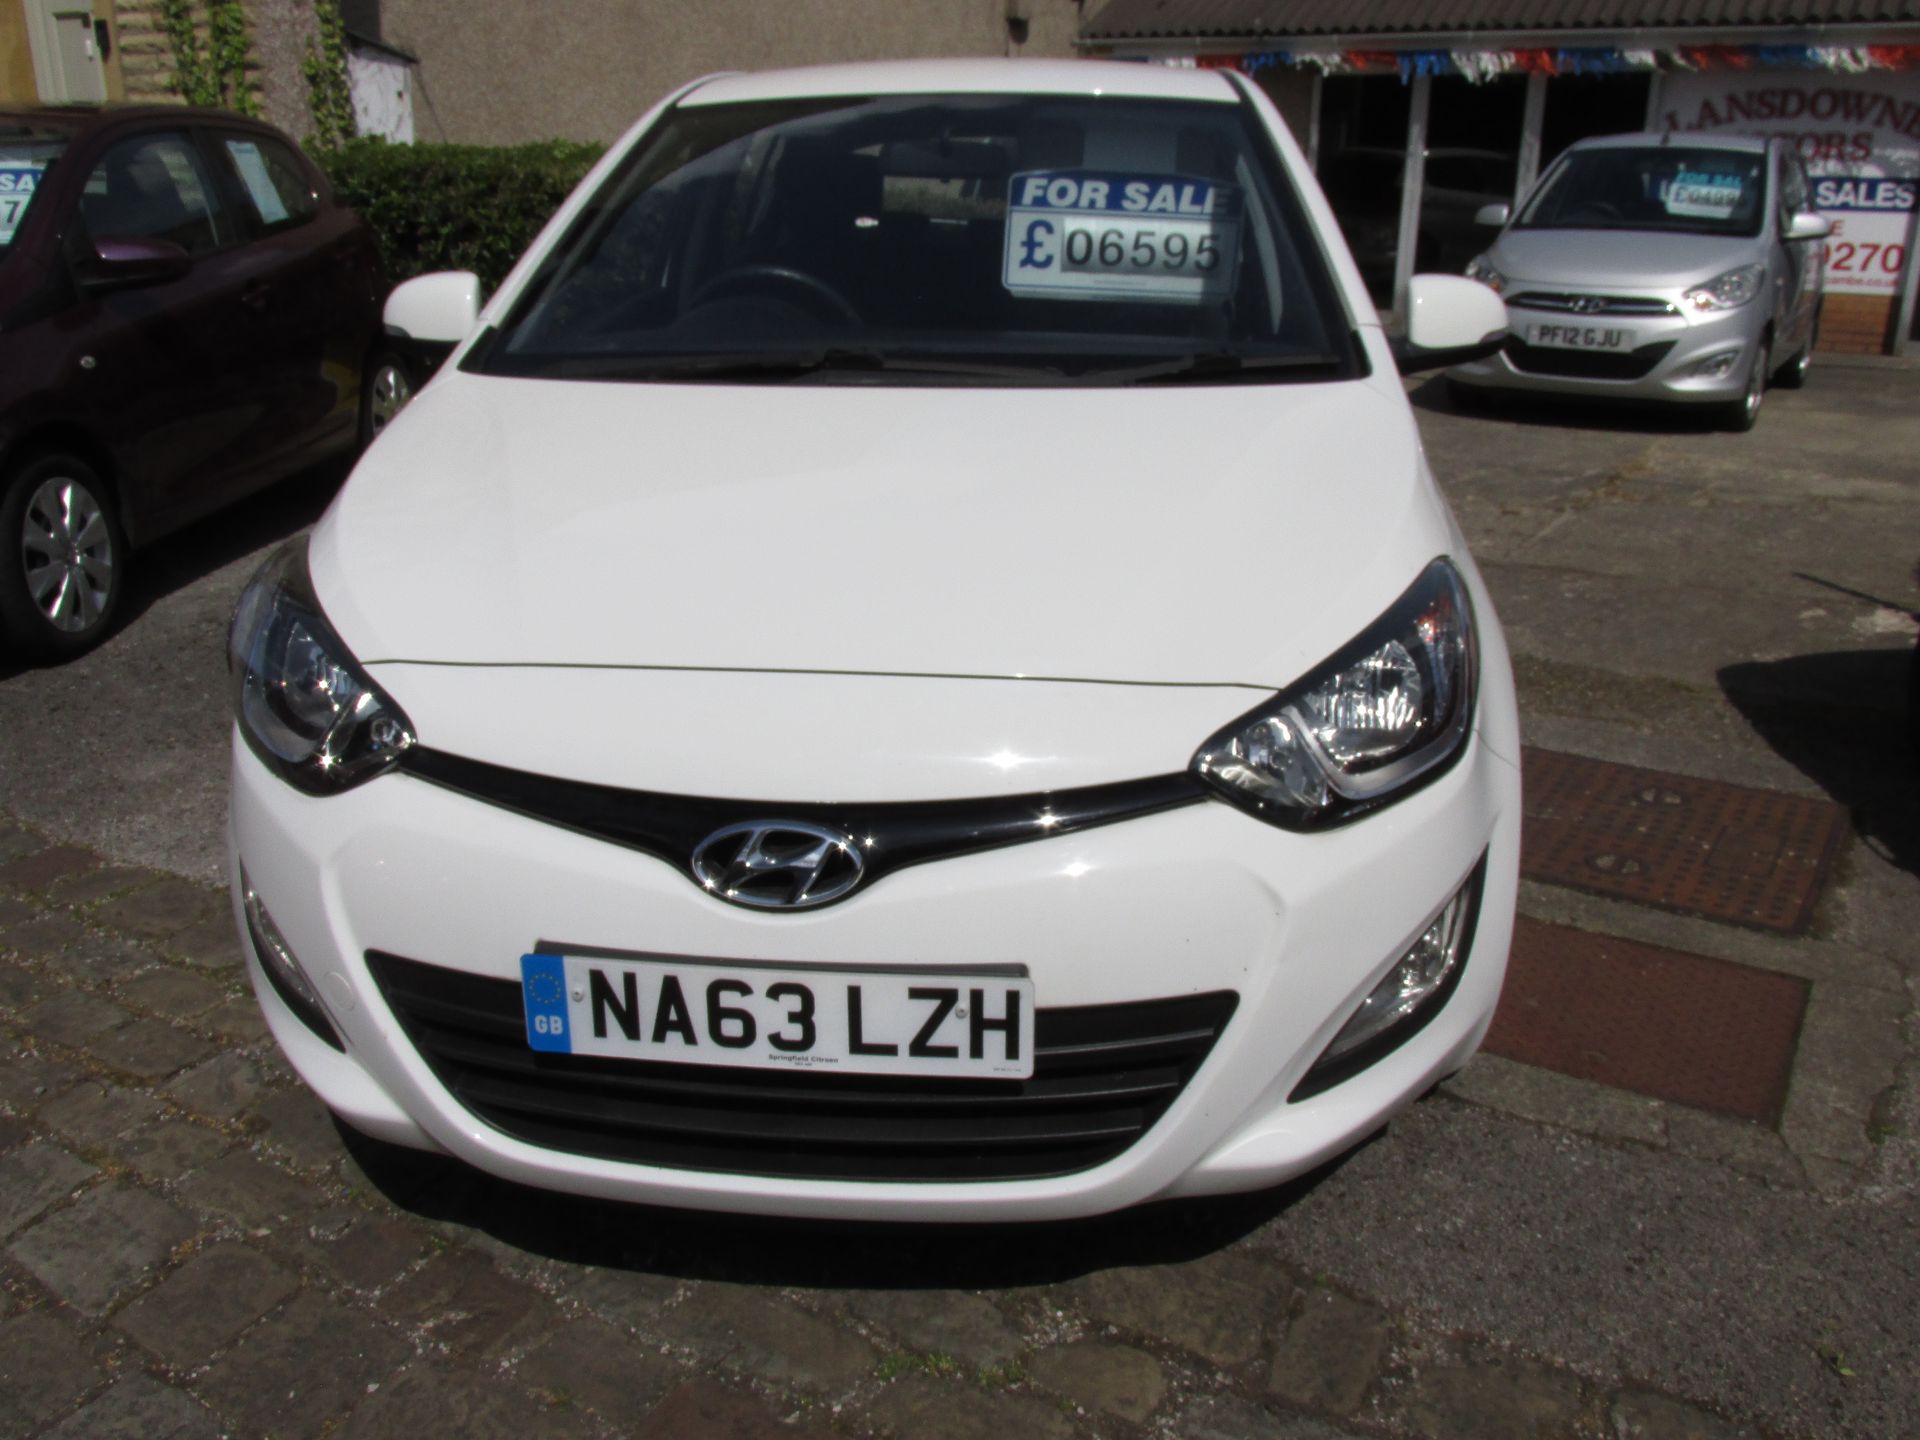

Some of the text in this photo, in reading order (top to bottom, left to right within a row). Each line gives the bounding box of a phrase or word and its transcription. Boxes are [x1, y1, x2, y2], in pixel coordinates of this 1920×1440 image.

[0, 173, 42, 191] SA
[1021, 178, 1109, 208] FOR
[1816, 180, 1914, 208] SALES
[534, 1014, 564, 1036] GB
[588, 968, 1021, 1061] NA63 LZH
